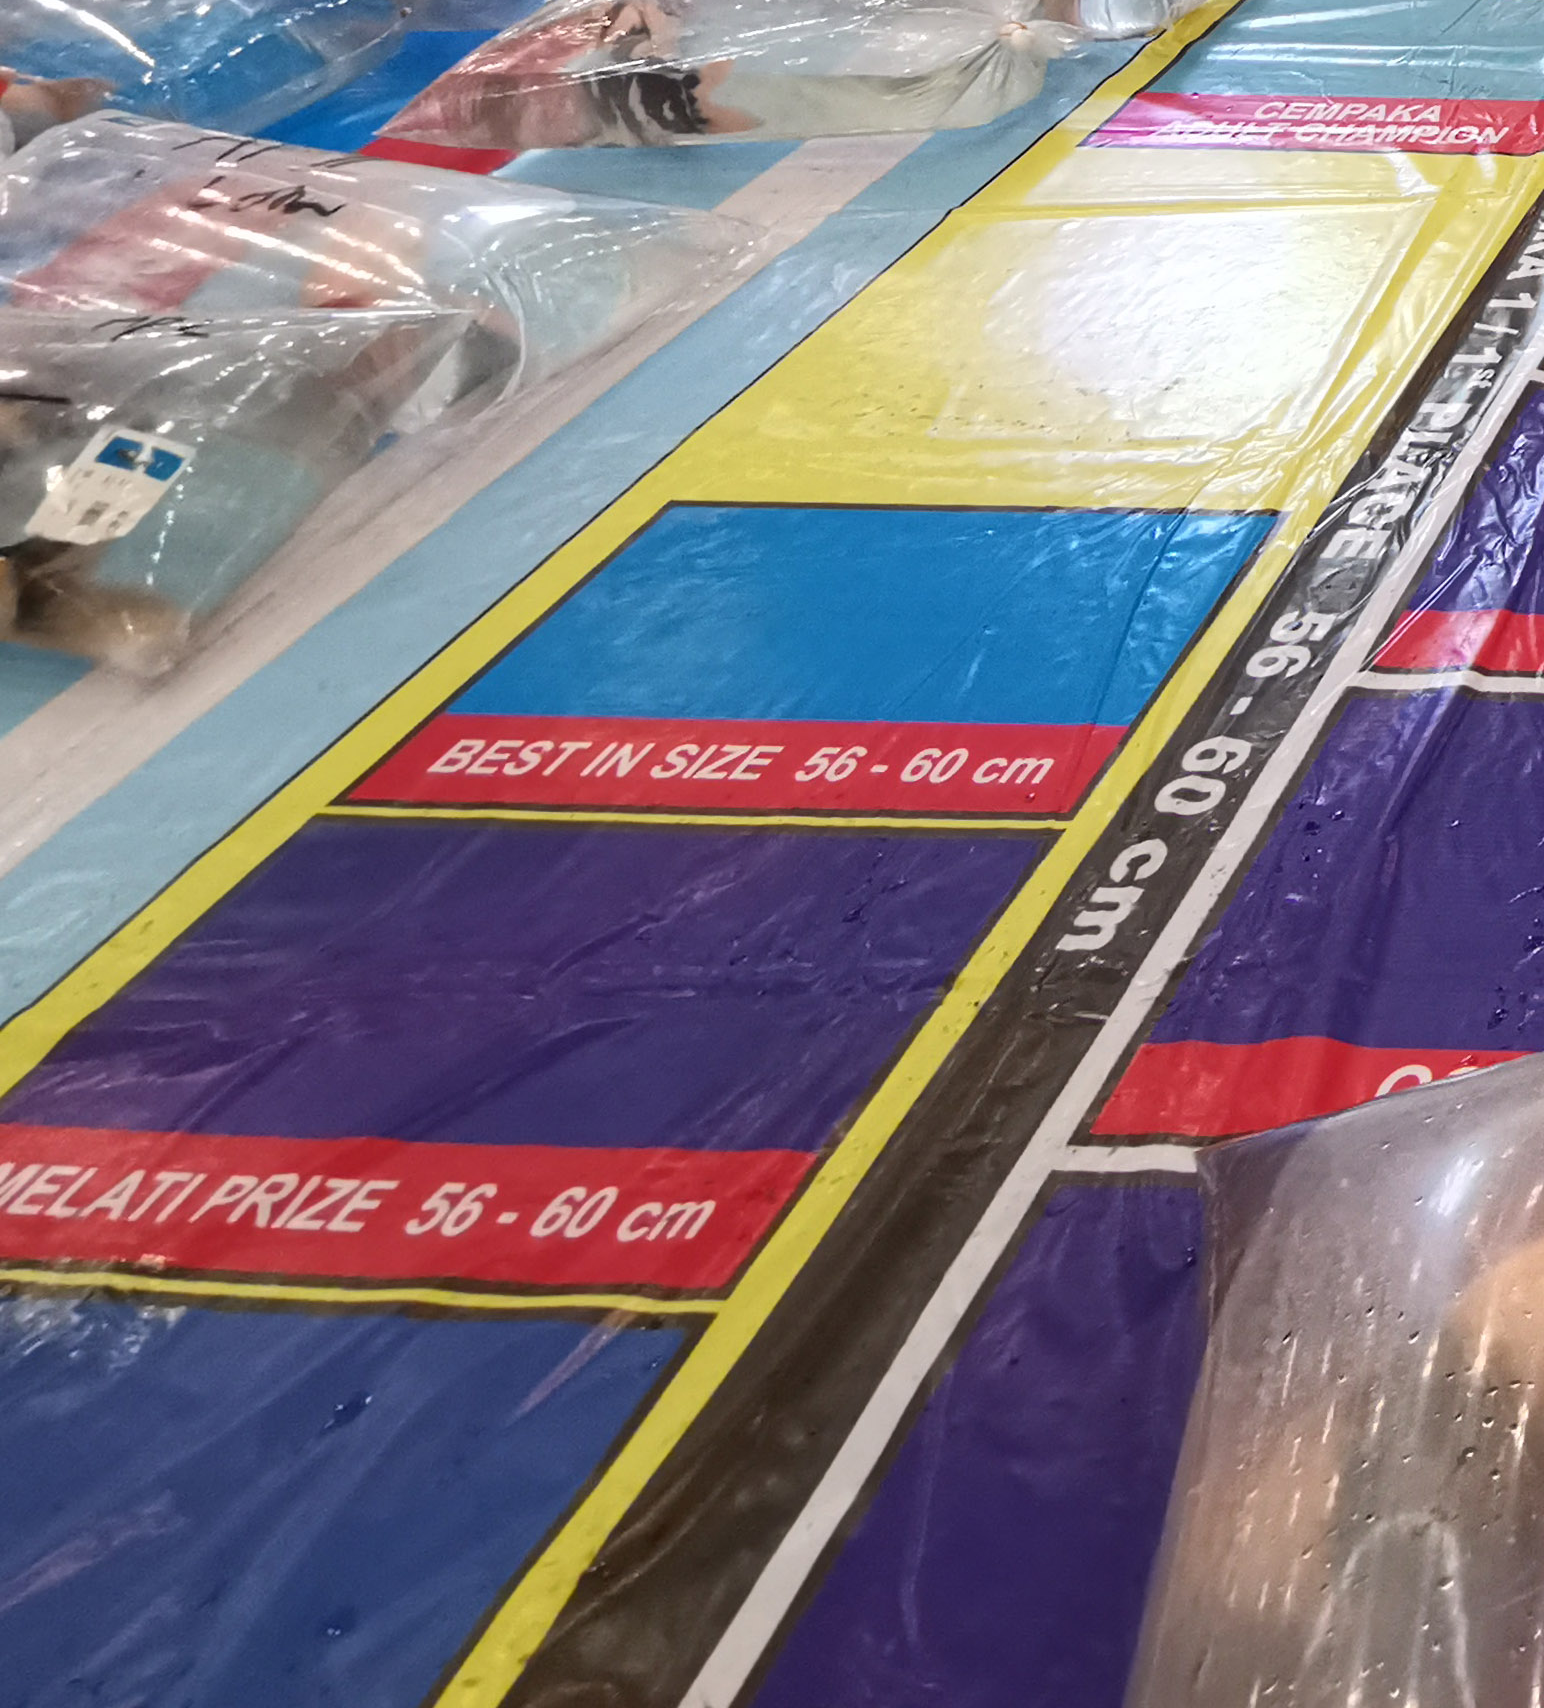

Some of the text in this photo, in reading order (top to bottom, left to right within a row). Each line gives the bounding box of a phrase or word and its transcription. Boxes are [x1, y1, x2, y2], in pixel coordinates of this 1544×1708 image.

[1253, 101, 1443, 123] CEMPAKA
[1291, 122, 1510, 146] CHAMPION
[1245, 610, 1330, 679] 56
[426, 738, 589, 778] BEST
[586, 742, 650, 779] IN
[651, 744, 783, 784] SIZE
[793, 745, 870, 784] 56
[898, 747, 971, 786] 60
[972, 751, 1054, 787] cm
[1154, 735, 1253, 817] 60
[1055, 839, 1169, 952] cm
[0, 1161, 208, 1224] MELATI
[187, 1173, 399, 1235] PRIZE
[404, 1182, 486, 1238] 56
[529, 1186, 621, 1242] 60
[614, 1190, 717, 1243] cm
